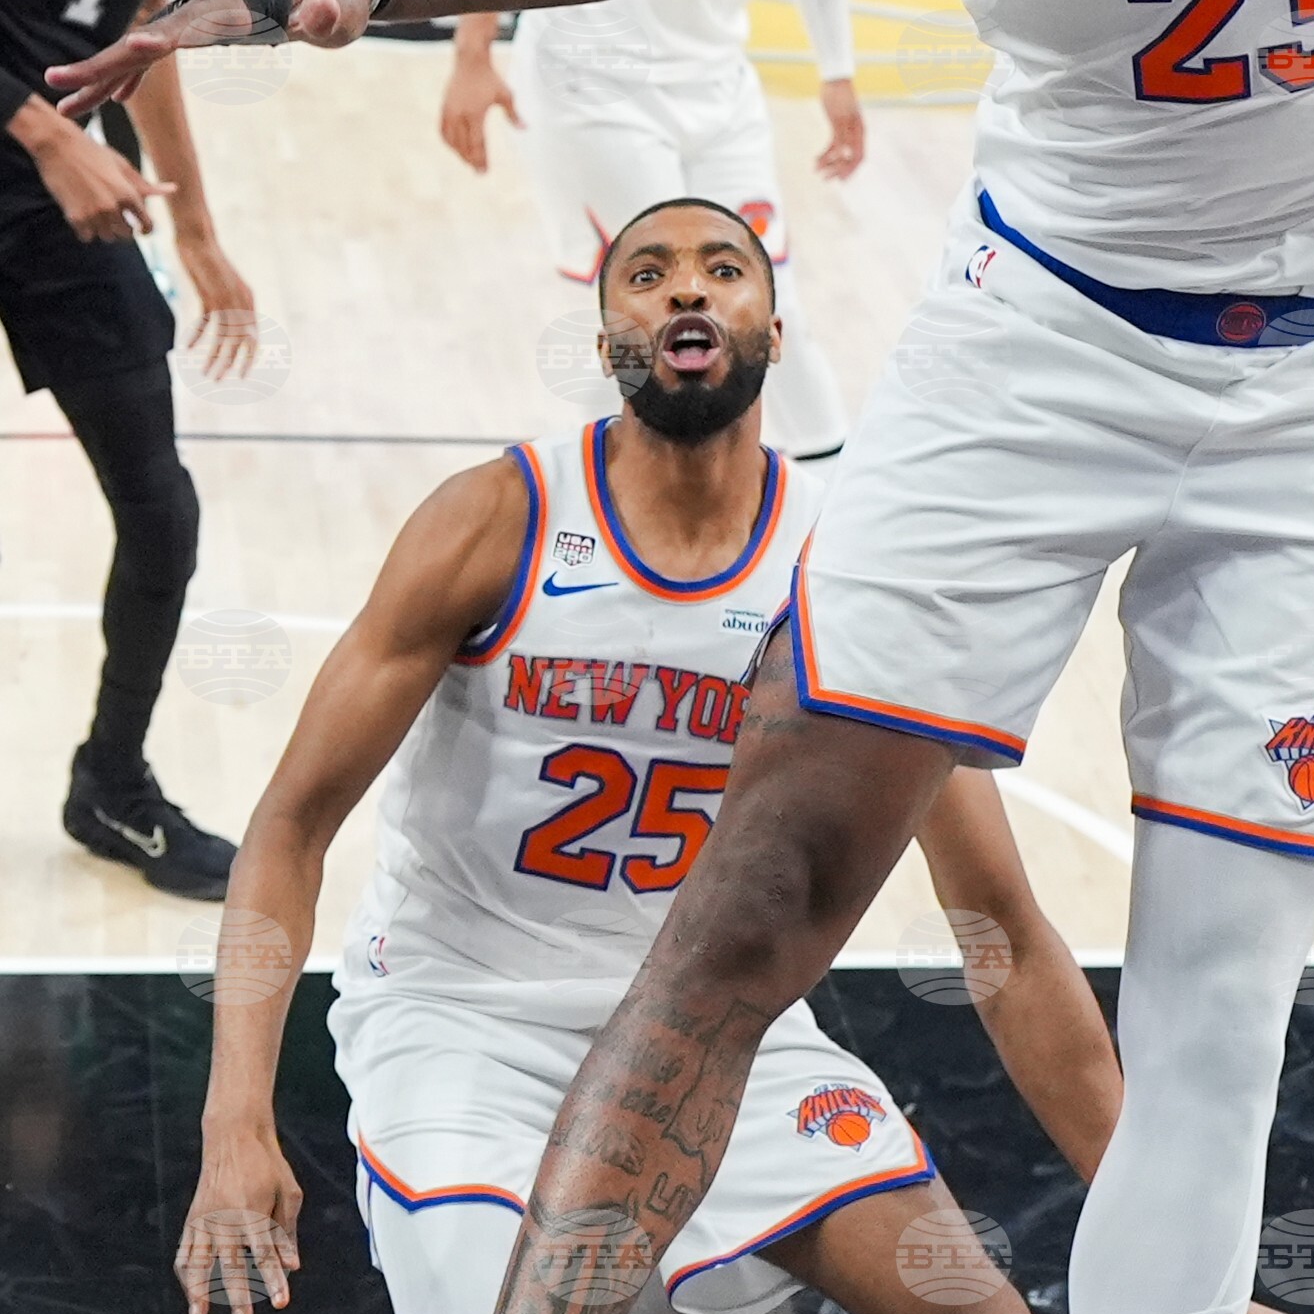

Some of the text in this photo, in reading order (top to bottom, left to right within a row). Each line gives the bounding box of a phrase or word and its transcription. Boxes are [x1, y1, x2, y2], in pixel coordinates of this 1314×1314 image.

[504, 654, 651, 725] NEW
[513, 743, 734, 895] 25
[797, 1087, 887, 1135] KNICKS
